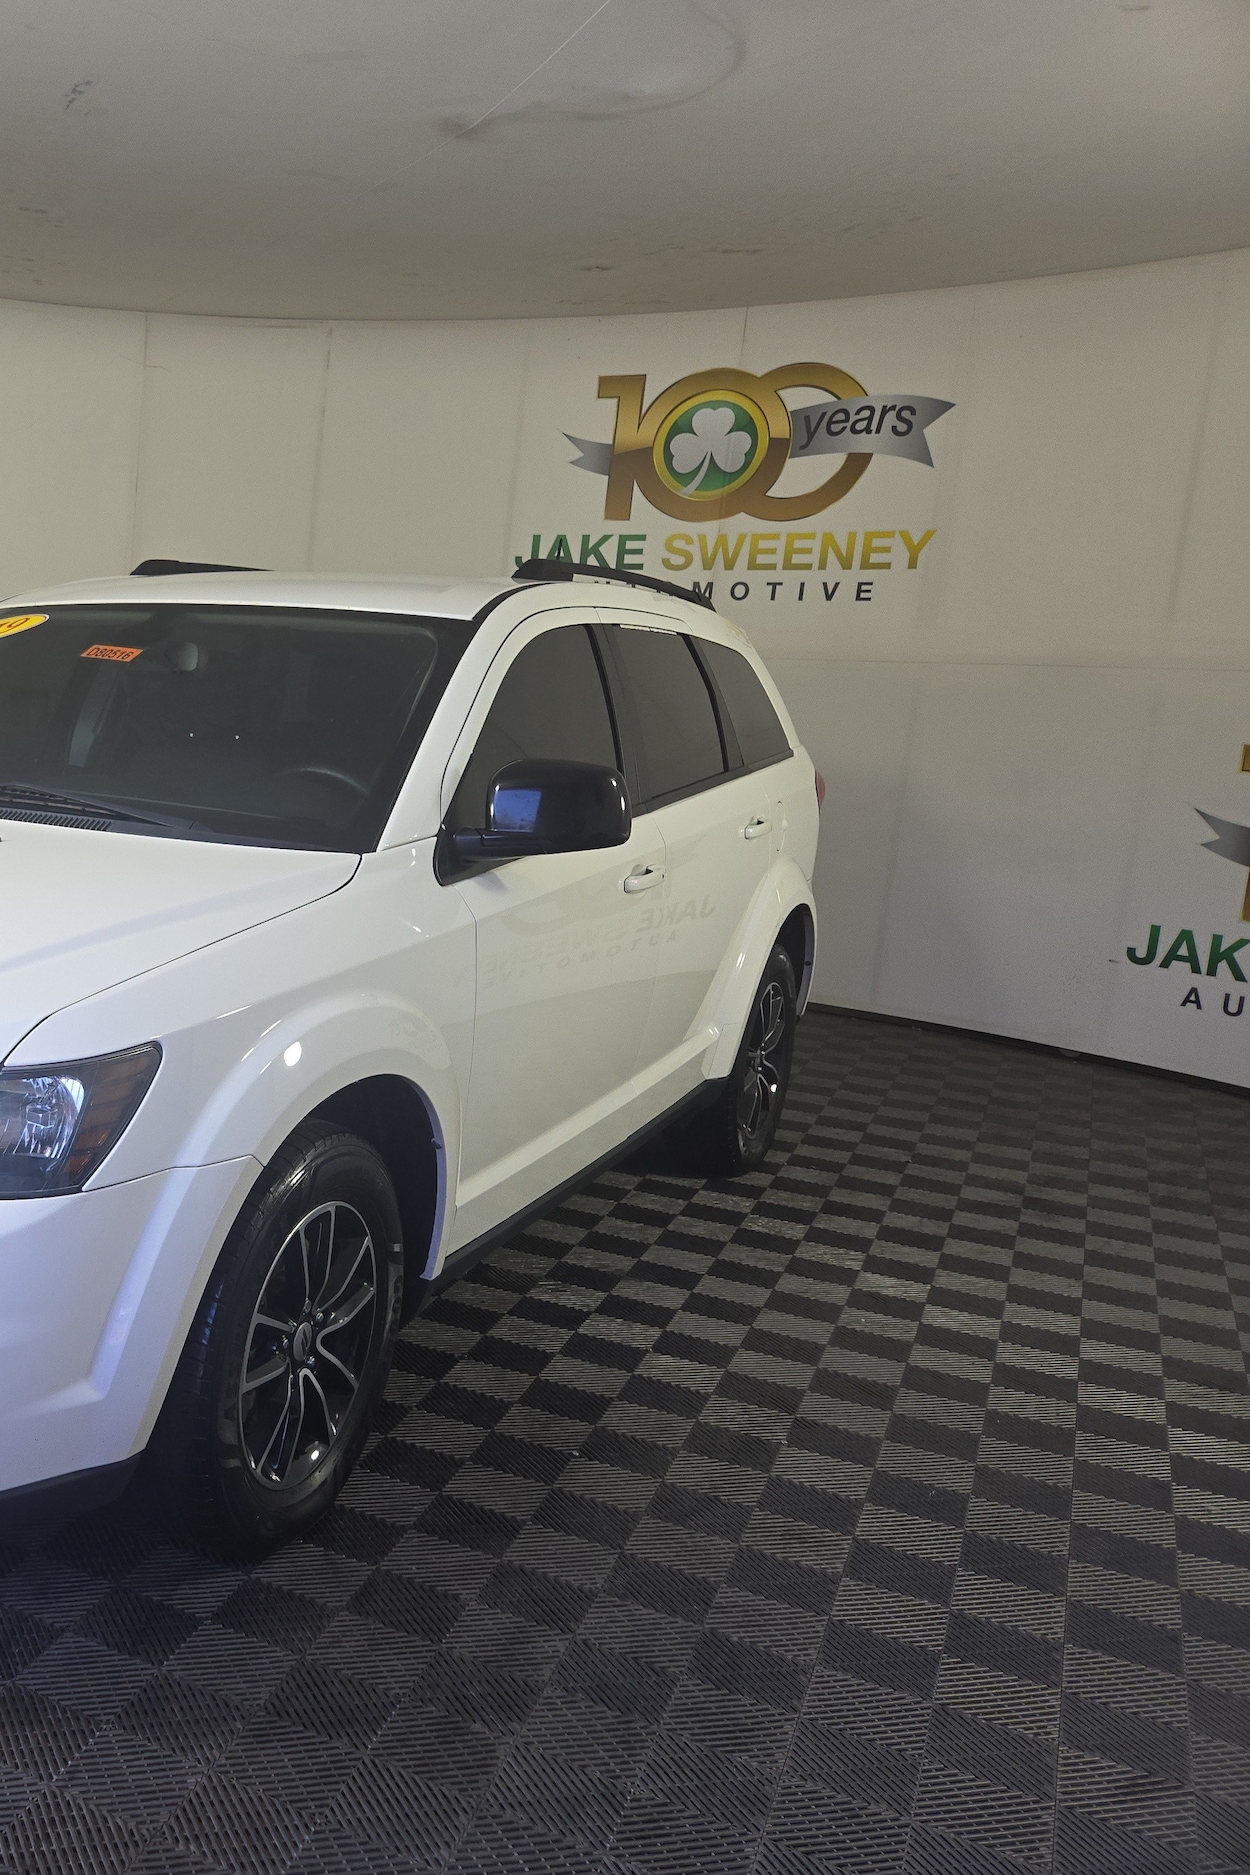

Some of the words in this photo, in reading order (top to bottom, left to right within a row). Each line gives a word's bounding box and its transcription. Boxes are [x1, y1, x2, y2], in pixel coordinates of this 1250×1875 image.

[798, 400, 917, 450] years
[515, 534, 647, 571] JAKE
[661, 529, 937, 571] SWEENEY
[1126, 924, 1249, 983] JAK
[1180, 986, 1246, 1017] AU
